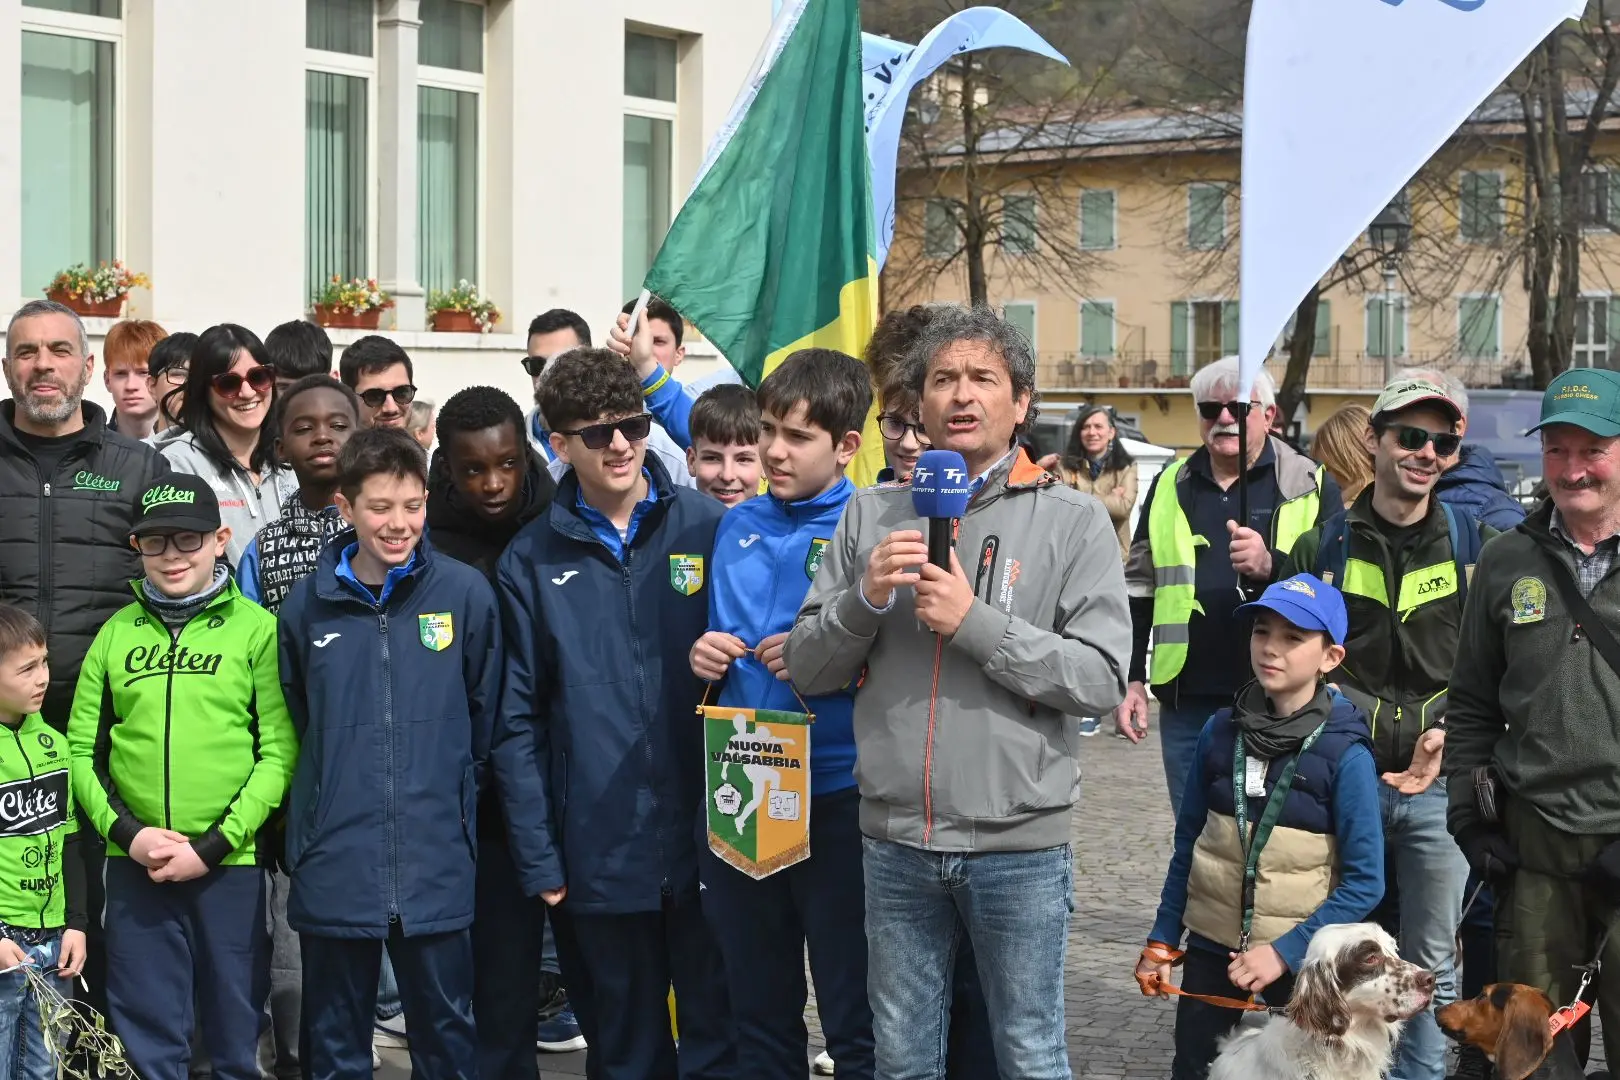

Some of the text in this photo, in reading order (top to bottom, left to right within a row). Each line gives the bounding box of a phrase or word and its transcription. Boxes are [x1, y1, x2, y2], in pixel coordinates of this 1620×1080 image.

[73, 470, 120, 491] Cléten
[142, 484, 195, 506] Cléten
[729, 741, 783, 754] NUOVA
[711, 751, 801, 769] VALSABBIA
[0, 787, 58, 822] Cléte
